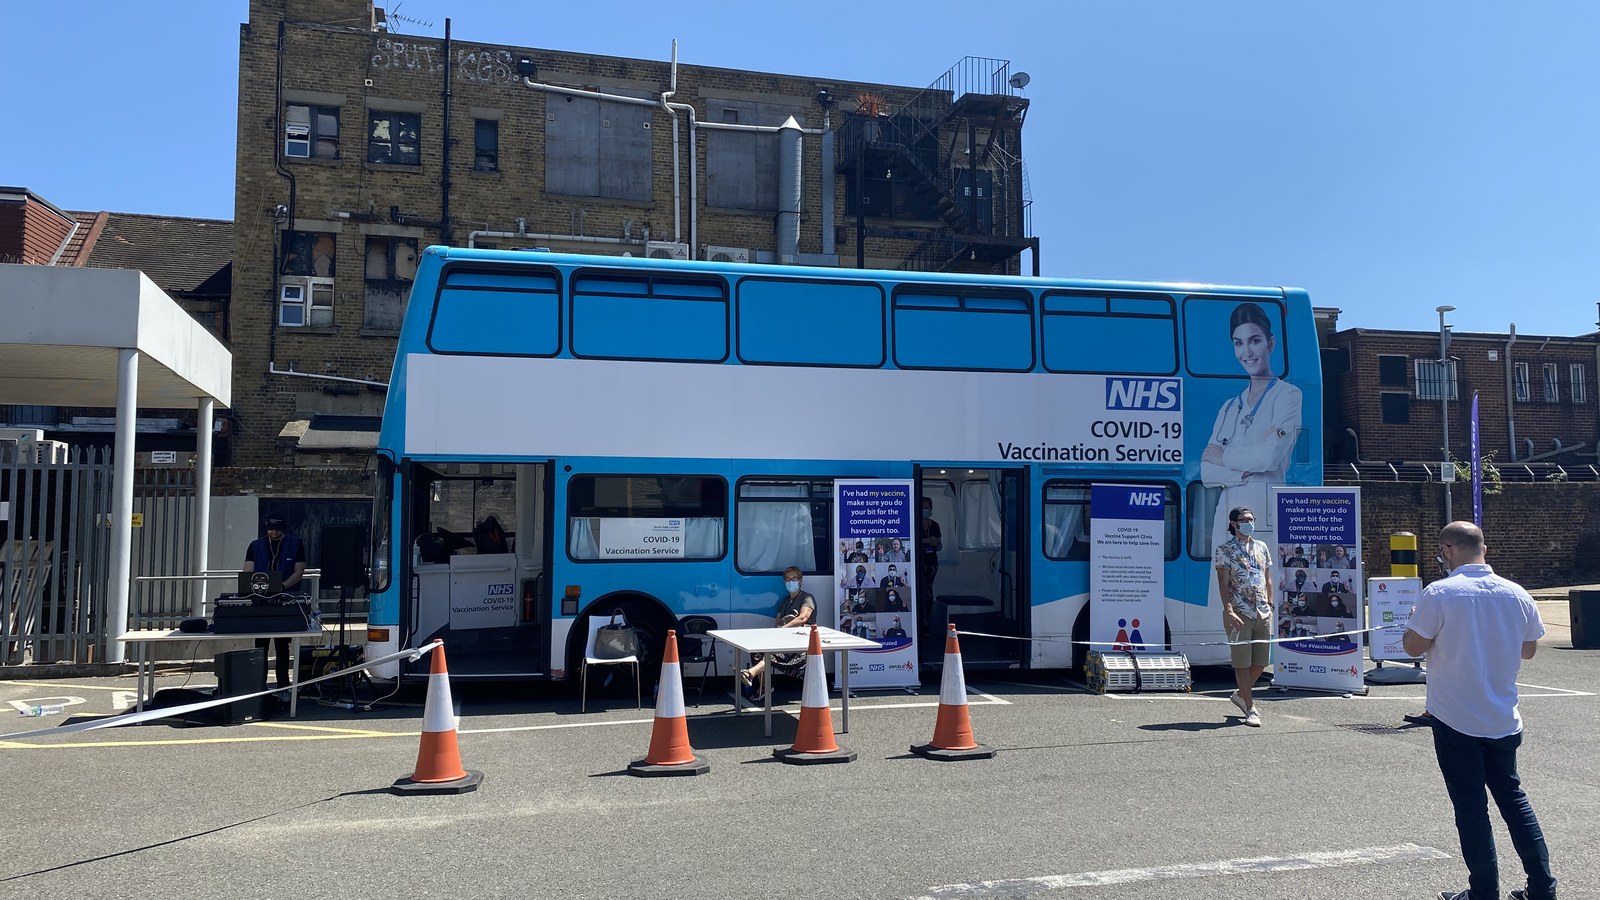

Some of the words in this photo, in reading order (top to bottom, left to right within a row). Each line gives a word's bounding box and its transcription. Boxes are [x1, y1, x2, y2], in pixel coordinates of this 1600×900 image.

[1108, 380, 1178, 408] NHS
[1091, 420, 1182, 439] COVID-19
[998, 442, 1109, 461] Vaccination
[1115, 444, 1182, 462] Service
[1129, 492, 1161, 506] NHS
[849, 518, 886, 526] community
[867, 528, 886, 536] yours
[1288, 525, 1329, 533] community
[605, 547, 650, 555] Vaccination
[489, 585, 512, 594] NHS
